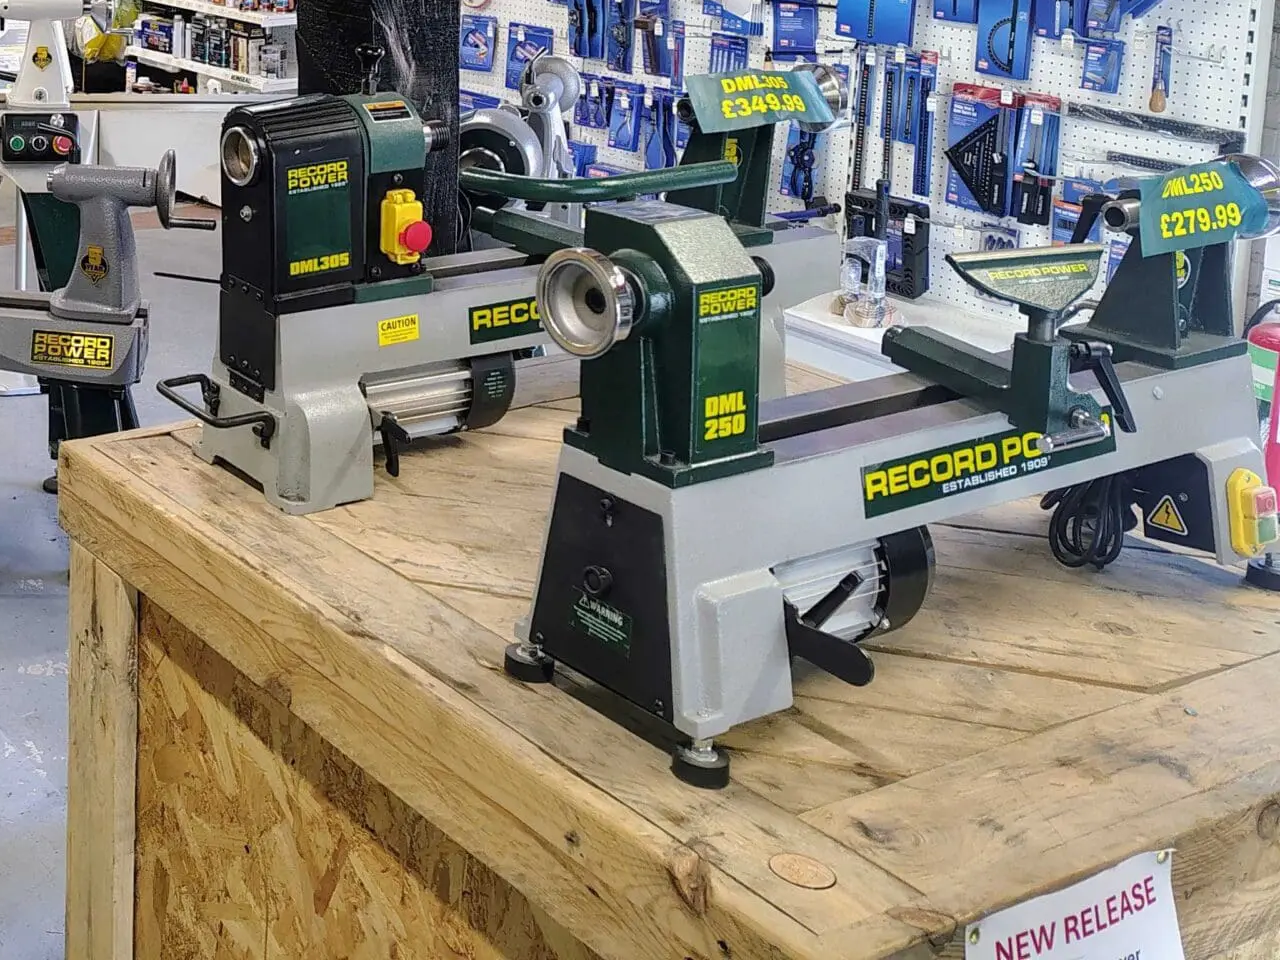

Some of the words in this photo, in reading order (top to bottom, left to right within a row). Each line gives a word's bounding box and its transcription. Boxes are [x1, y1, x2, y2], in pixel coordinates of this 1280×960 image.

[721, 74, 788, 94] DML305
[721, 93, 806, 118] £349.99
[287, 160, 348, 180] RECORD
[288, 170, 348, 190] POWER
[1162, 171, 1224, 198] DML250
[1160, 202, 1242, 239] £279.99
[290, 252, 350, 276] DML305
[987, 268, 1041, 280] RECORD
[1041, 263, 1089, 275] POWER
[699, 286, 757, 305] RECORD
[699, 297, 757, 316] POWER
[380, 316, 417, 332] CAUTION
[472, 300, 541, 331] RECO
[33, 343, 110, 360] POWER
[34, 332, 111, 349] RECORD
[704, 391, 747, 416] DML
[704, 414, 746, 441] 250
[864, 442, 999, 501] RECORD
[941, 465, 1018, 494] ESTABLISHED
[1020, 457, 1049, 473] 1909
[994, 921, 1056, 960] NEW
[1063, 876, 1157, 944] RELEASE
